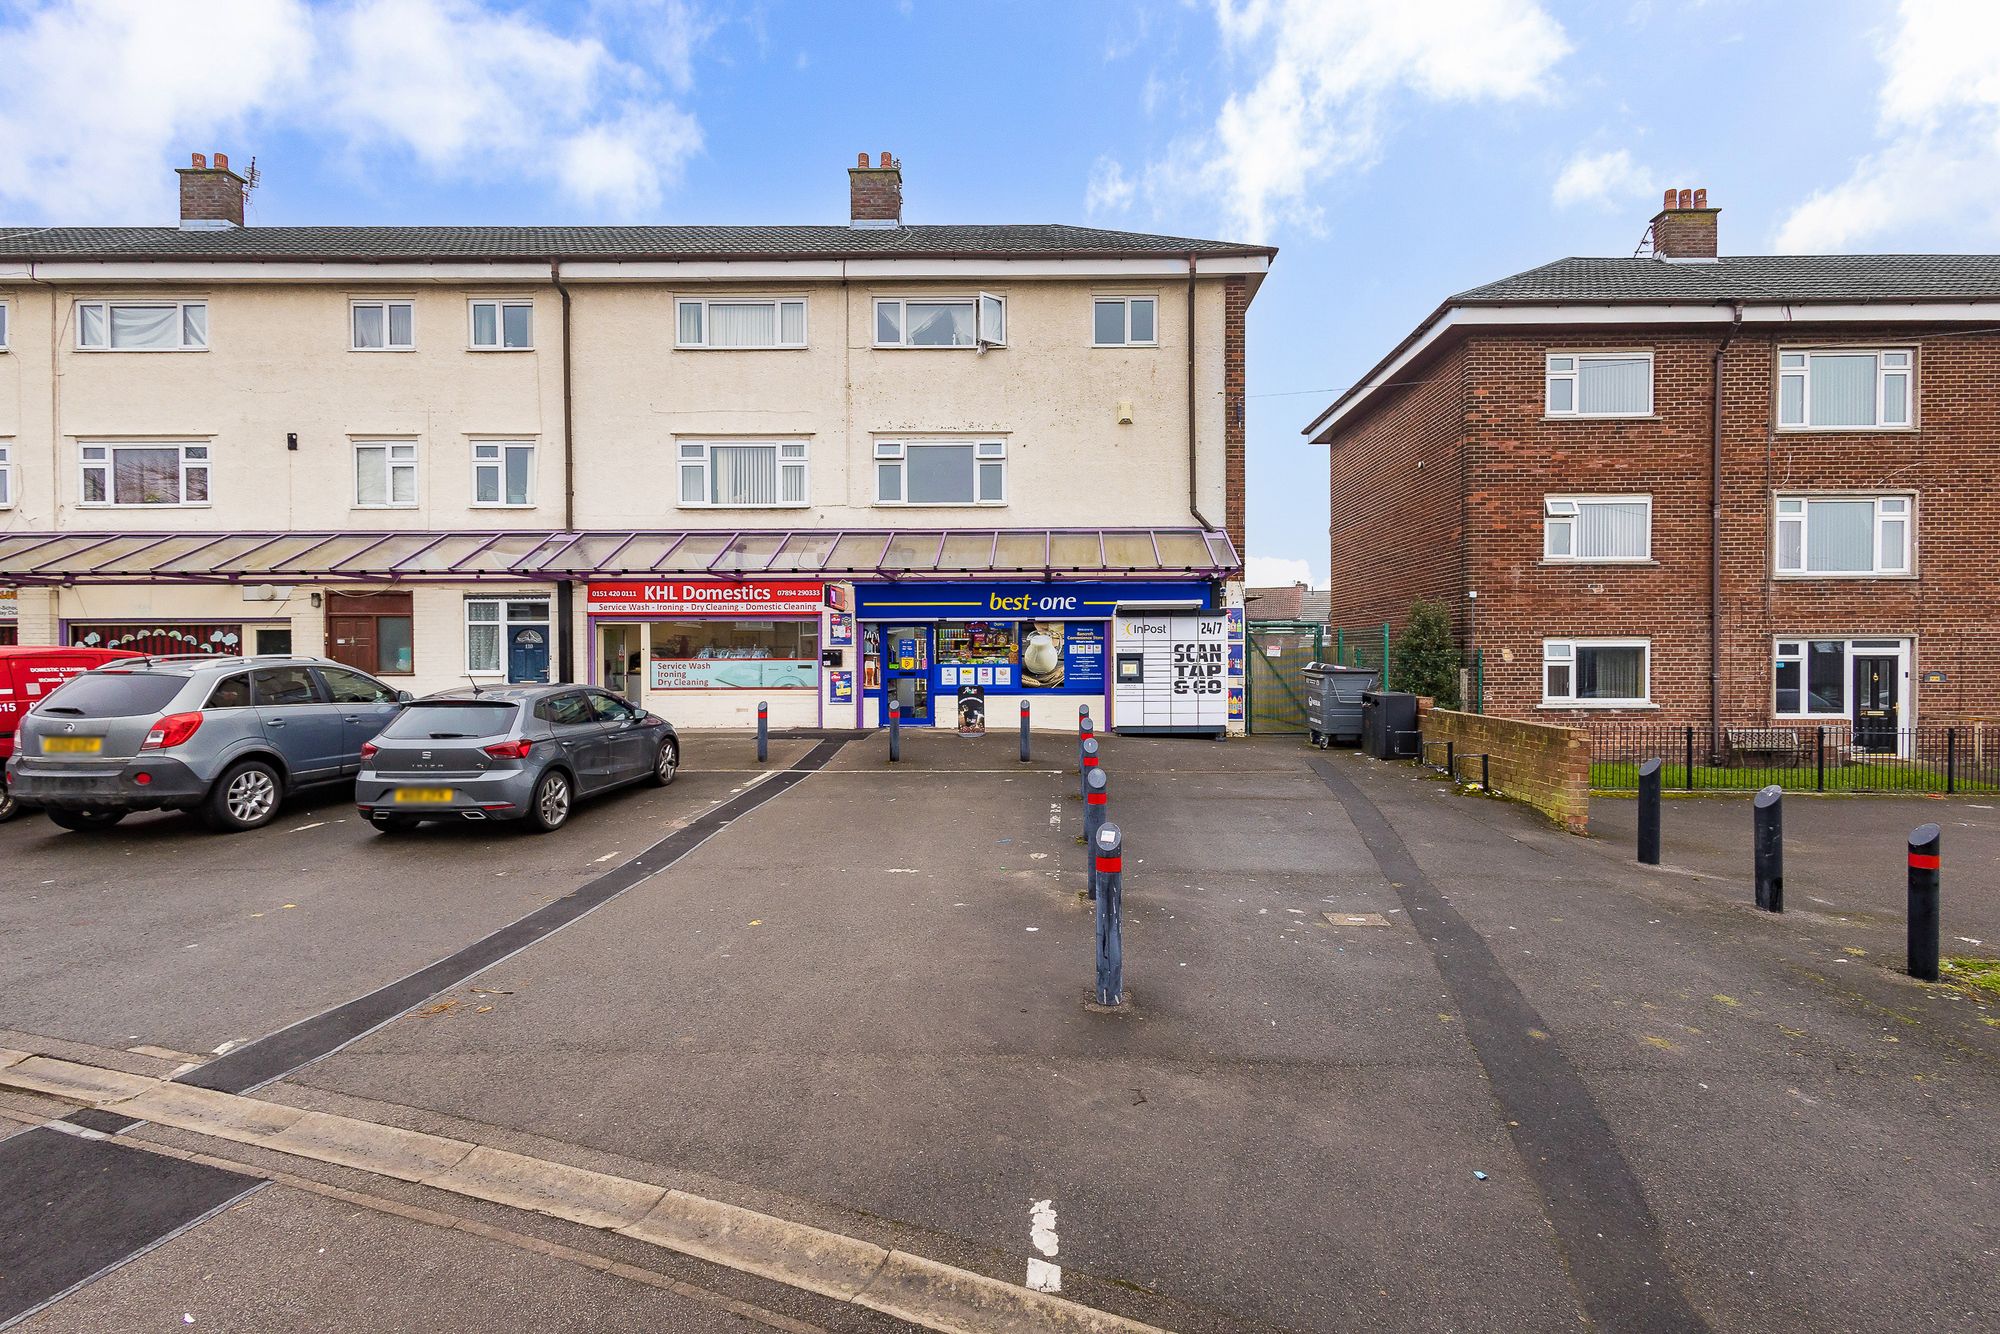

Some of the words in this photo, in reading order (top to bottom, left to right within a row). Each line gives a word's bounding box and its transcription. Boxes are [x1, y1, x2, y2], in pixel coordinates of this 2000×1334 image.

[644, 585, 678, 600] KHL
[682, 585, 771, 600] Domestics
[777, 589, 797, 597] 07894
[797, 589, 821, 597] 290333
[989, 592, 1077, 611] best-one
[656, 604, 684, 612] Ironing
[691, 604, 706, 612] Dry
[706, 604, 739, 612] Cleaning
[783, 604, 817, 612] Cleaning
[1133, 624, 1167, 634] InPost
[1200, 622, 1222, 635] 24/7
[1173, 644, 1222, 662] SCAN
[657, 662, 687, 670] Service
[688, 662, 711, 670] Wash
[657, 670, 687, 679] Ironing
[1174, 664, 1222, 680] TAP
[657, 678, 672, 687] Dry
[673, 678, 709, 687] Cleaning
[1173, 680, 1190, 694] &
[1193, 680, 1222, 694] GO
